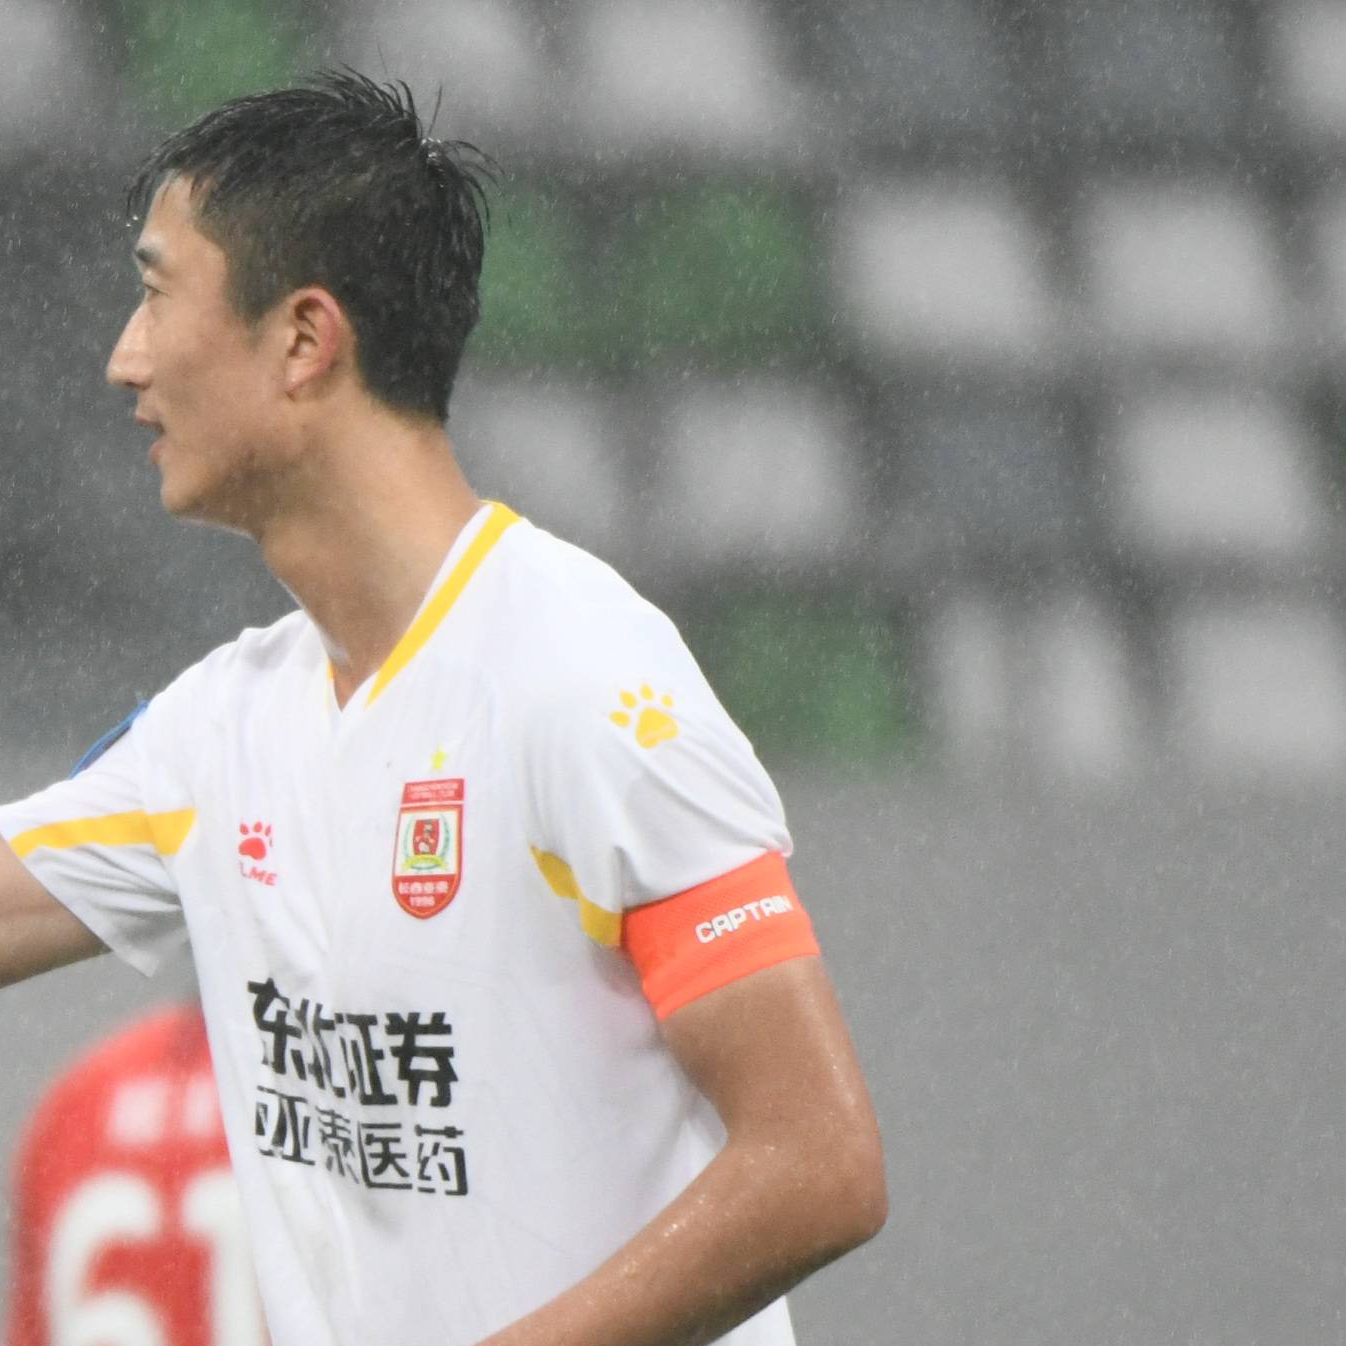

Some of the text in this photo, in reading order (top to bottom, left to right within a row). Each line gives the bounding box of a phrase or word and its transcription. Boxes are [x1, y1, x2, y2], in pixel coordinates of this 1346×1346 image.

[695, 895, 794, 944] CAPTAIN
[248, 977, 459, 1107] 东北证券
[255, 1085, 468, 1196] 亚泰医药
